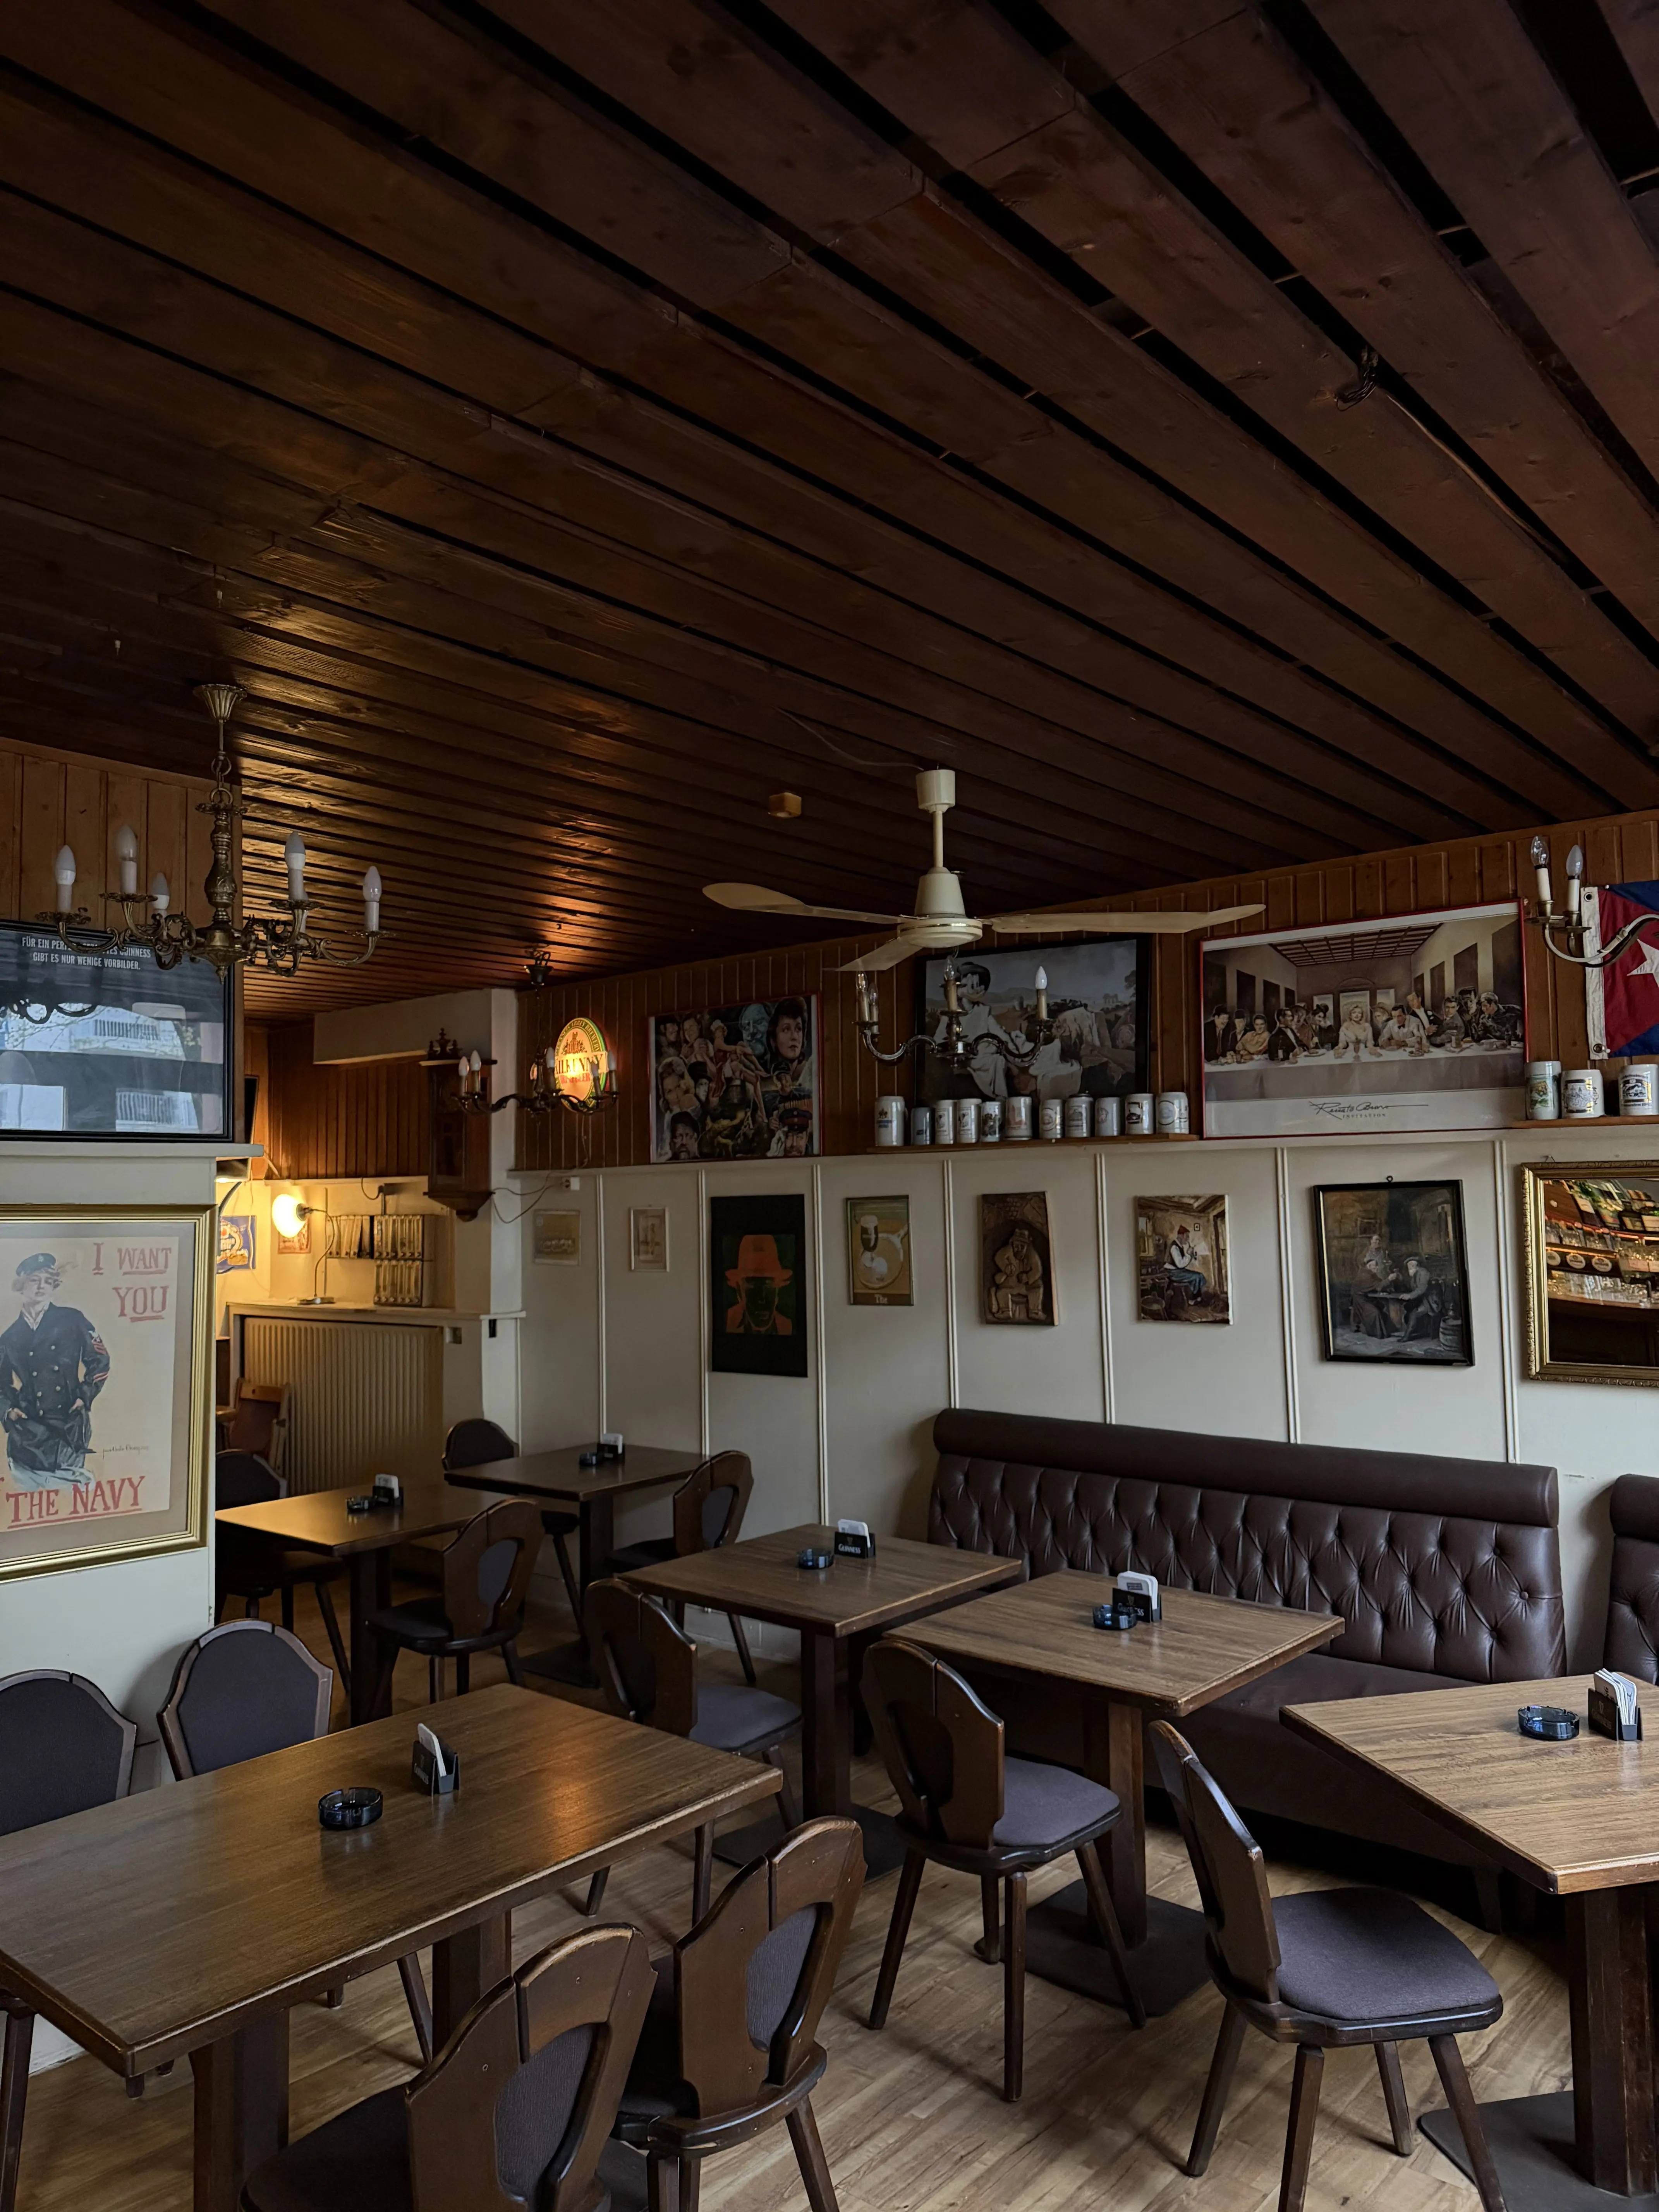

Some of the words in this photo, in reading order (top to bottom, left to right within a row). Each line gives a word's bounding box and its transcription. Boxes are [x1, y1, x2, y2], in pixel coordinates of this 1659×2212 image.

[22, 936, 35, 947] FÜR
[38, 938, 49, 949] EIN
[33, 952, 48, 962] GIBT
[51, 953, 59, 963] ES
[62, 955, 75, 964] NUR
[77, 956, 102, 967] WENIGE
[104, 958, 141, 970] VORBILDER.
[92, 1242, 104, 1271] I
[117, 1247, 172, 1271] WANT
[112, 1285, 169, 1317] YOU
[6, 1489, 59, 1523] THE
[69, 1475, 145, 1515] NAVY
